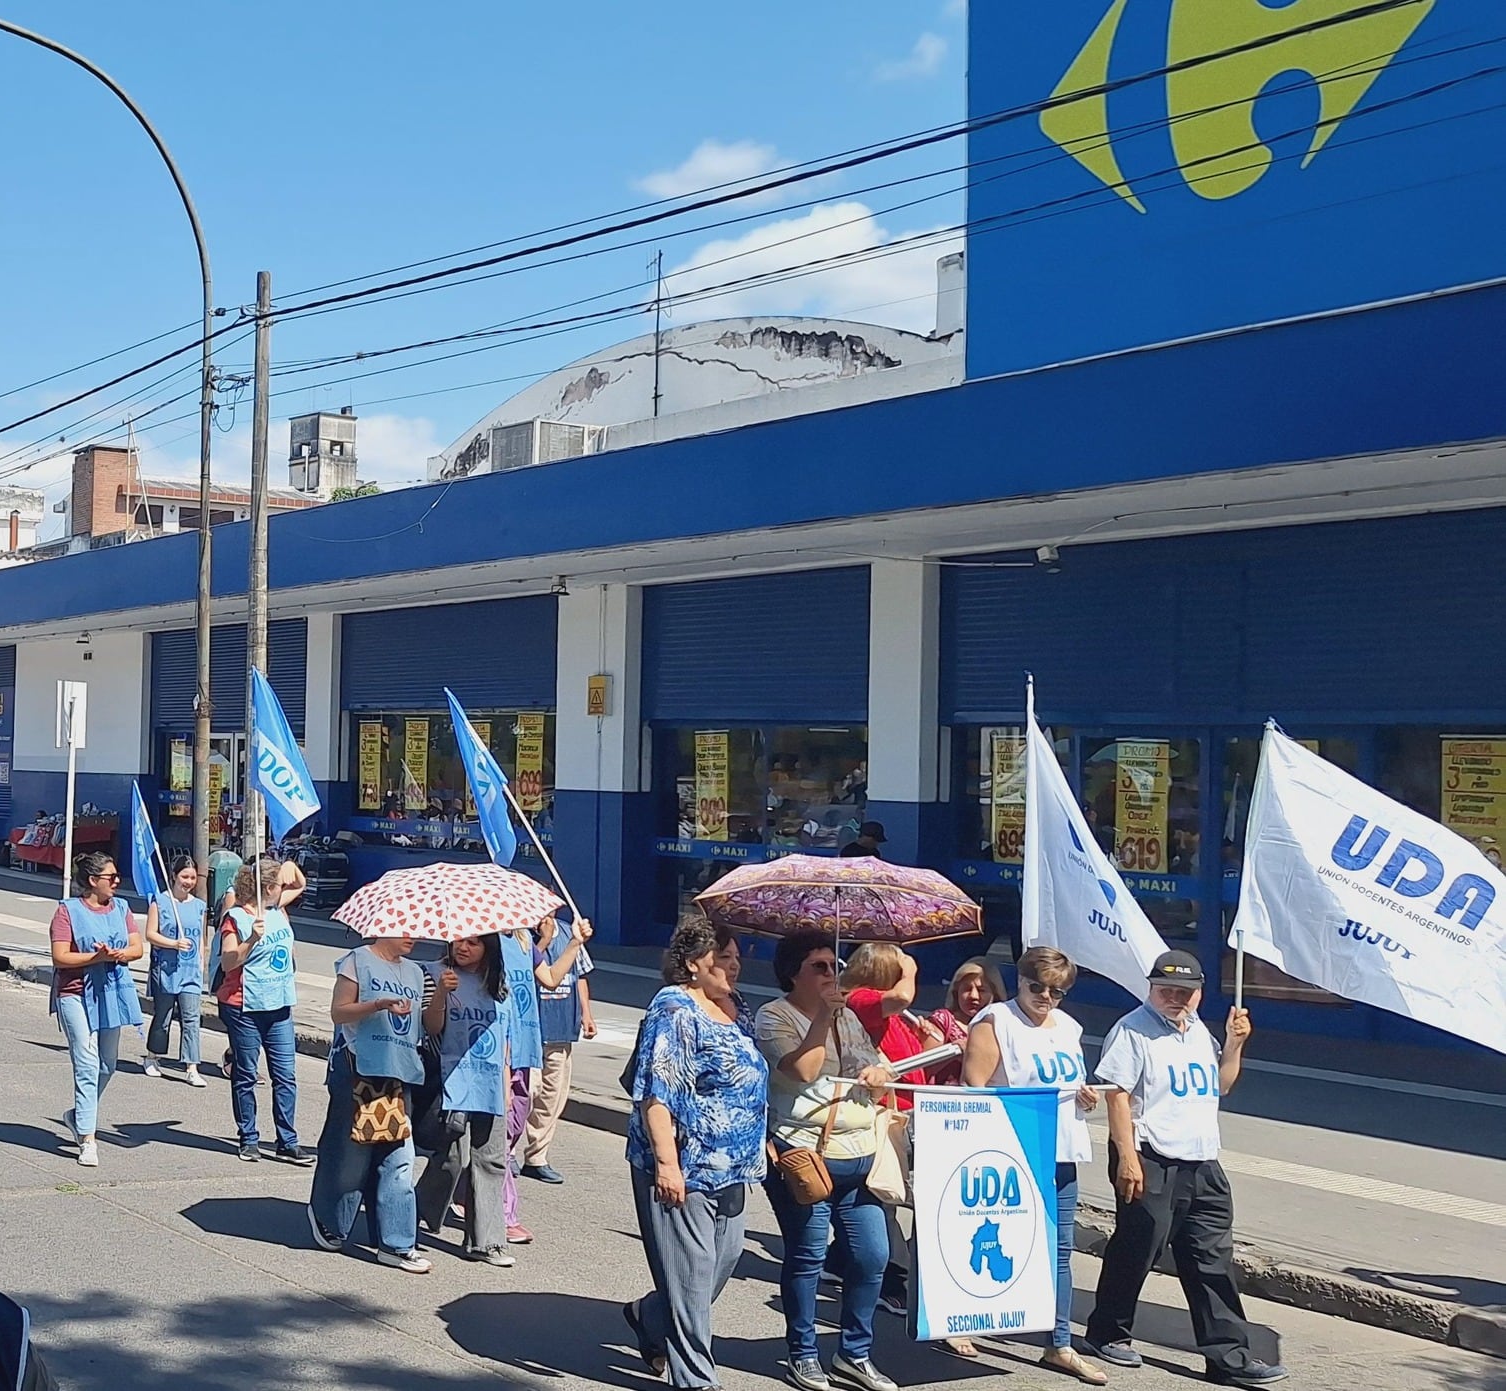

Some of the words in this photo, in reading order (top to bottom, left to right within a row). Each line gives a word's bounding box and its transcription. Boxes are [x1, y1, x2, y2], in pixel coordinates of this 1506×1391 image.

[1123, 745, 1161, 757] PROMO
[1449, 743, 1493, 754] OFERTA
[1447, 766, 1460, 789] 3
[379, 822, 396, 830] MAXI
[423, 825, 441, 833] MAXI
[453, 826, 470, 834] MAXI
[668, 843, 691, 853] MAXI
[722, 847, 747, 857] MAXI
[1120, 837, 1161, 871] 619
[1331, 815, 1496, 931] UDA
[1139, 879, 1177, 892] MAXI
[1351, 882, 1406, 915] DOCENTES
[1405, 910, 1474, 947] ARGENTINOS
[1338, 918, 1418, 961] JUJUY
[508, 969, 534, 983] ADO
[963, 1102, 992, 1114] GREMIAL
[960, 1166, 1022, 1208] UDA
[947, 1313, 996, 1333] SECCIONAL
[998, 1310, 1026, 1329] JUJUY
